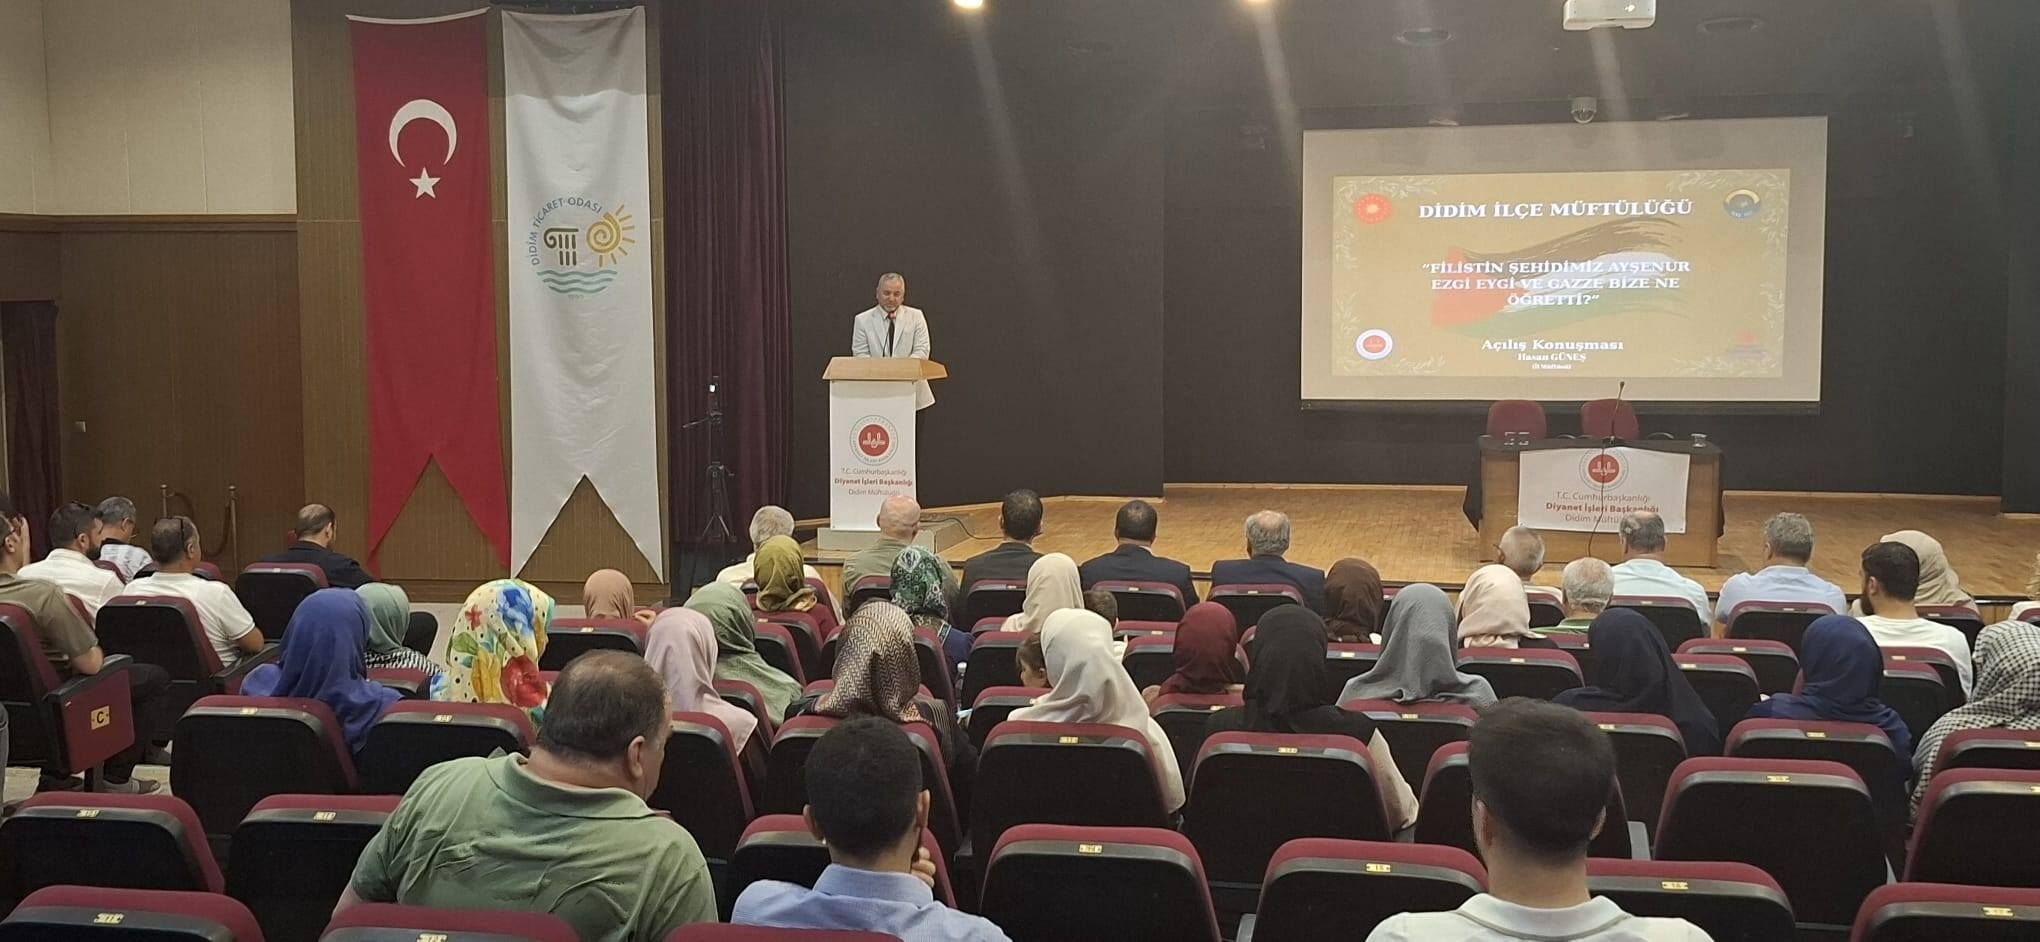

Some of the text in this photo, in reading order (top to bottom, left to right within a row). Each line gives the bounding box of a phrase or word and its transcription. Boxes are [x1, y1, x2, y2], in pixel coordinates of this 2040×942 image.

[1419, 198, 1693, 220] DİDİM İLÇE MÜFTÜLÜĞÜ
[527, 197, 603, 266] DİDİM TİCARET ODASI
[1508, 261, 1602, 275] ŞEHİDİMİZ
[1608, 261, 1690, 274] AYŞENUR
[1431, 276, 1680, 290] EZGİ EYGİ VE GAZZE BİZE NE
[1481, 339, 1623, 351] Açılış Konuşması
[1518, 351, 1587, 362] Hasan GÜNEŞ
[834, 478, 860, 486] Diyanet
[861, 478, 878, 486] İşleri
[1556, 491, 1570, 499] T.C.
[1546, 502, 1582, 513] Diyanet
[1584, 502, 1608, 514] İşleri
[1565, 514, 1591, 523] Didim
[96, 711, 105, 724] C
